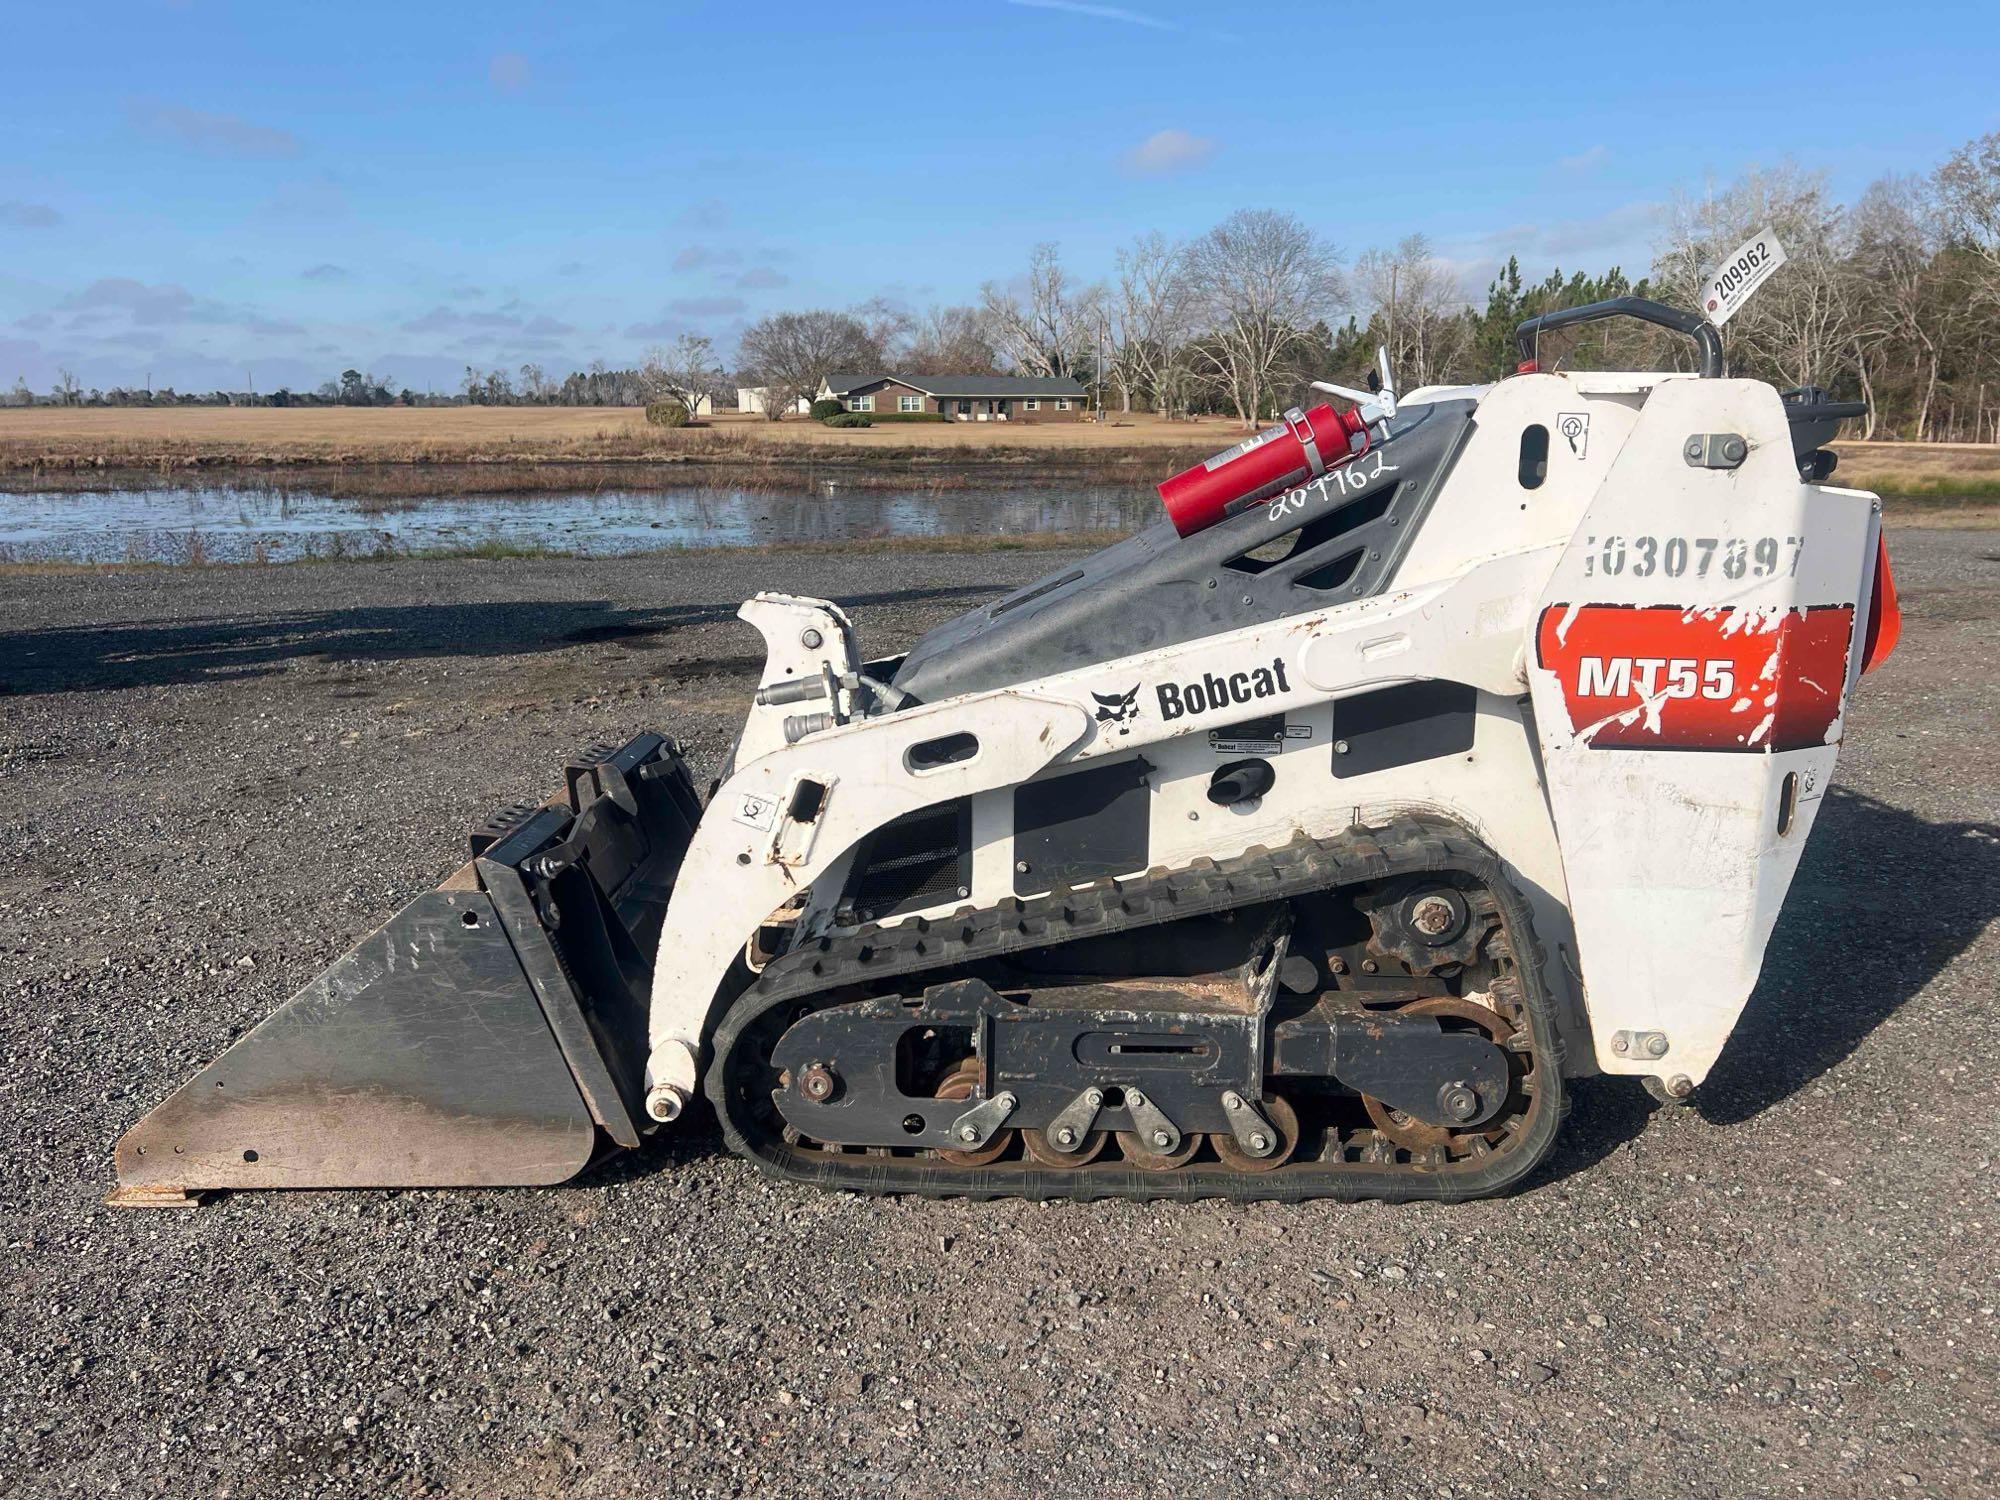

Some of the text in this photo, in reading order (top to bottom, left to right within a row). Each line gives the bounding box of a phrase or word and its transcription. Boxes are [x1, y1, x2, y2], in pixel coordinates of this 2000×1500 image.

[1715, 242, 1770, 300] 209962
[1269, 449, 1399, 522] 209962
[1156, 657, 1292, 721] Bobcat
[1577, 656, 1735, 700] MT55
